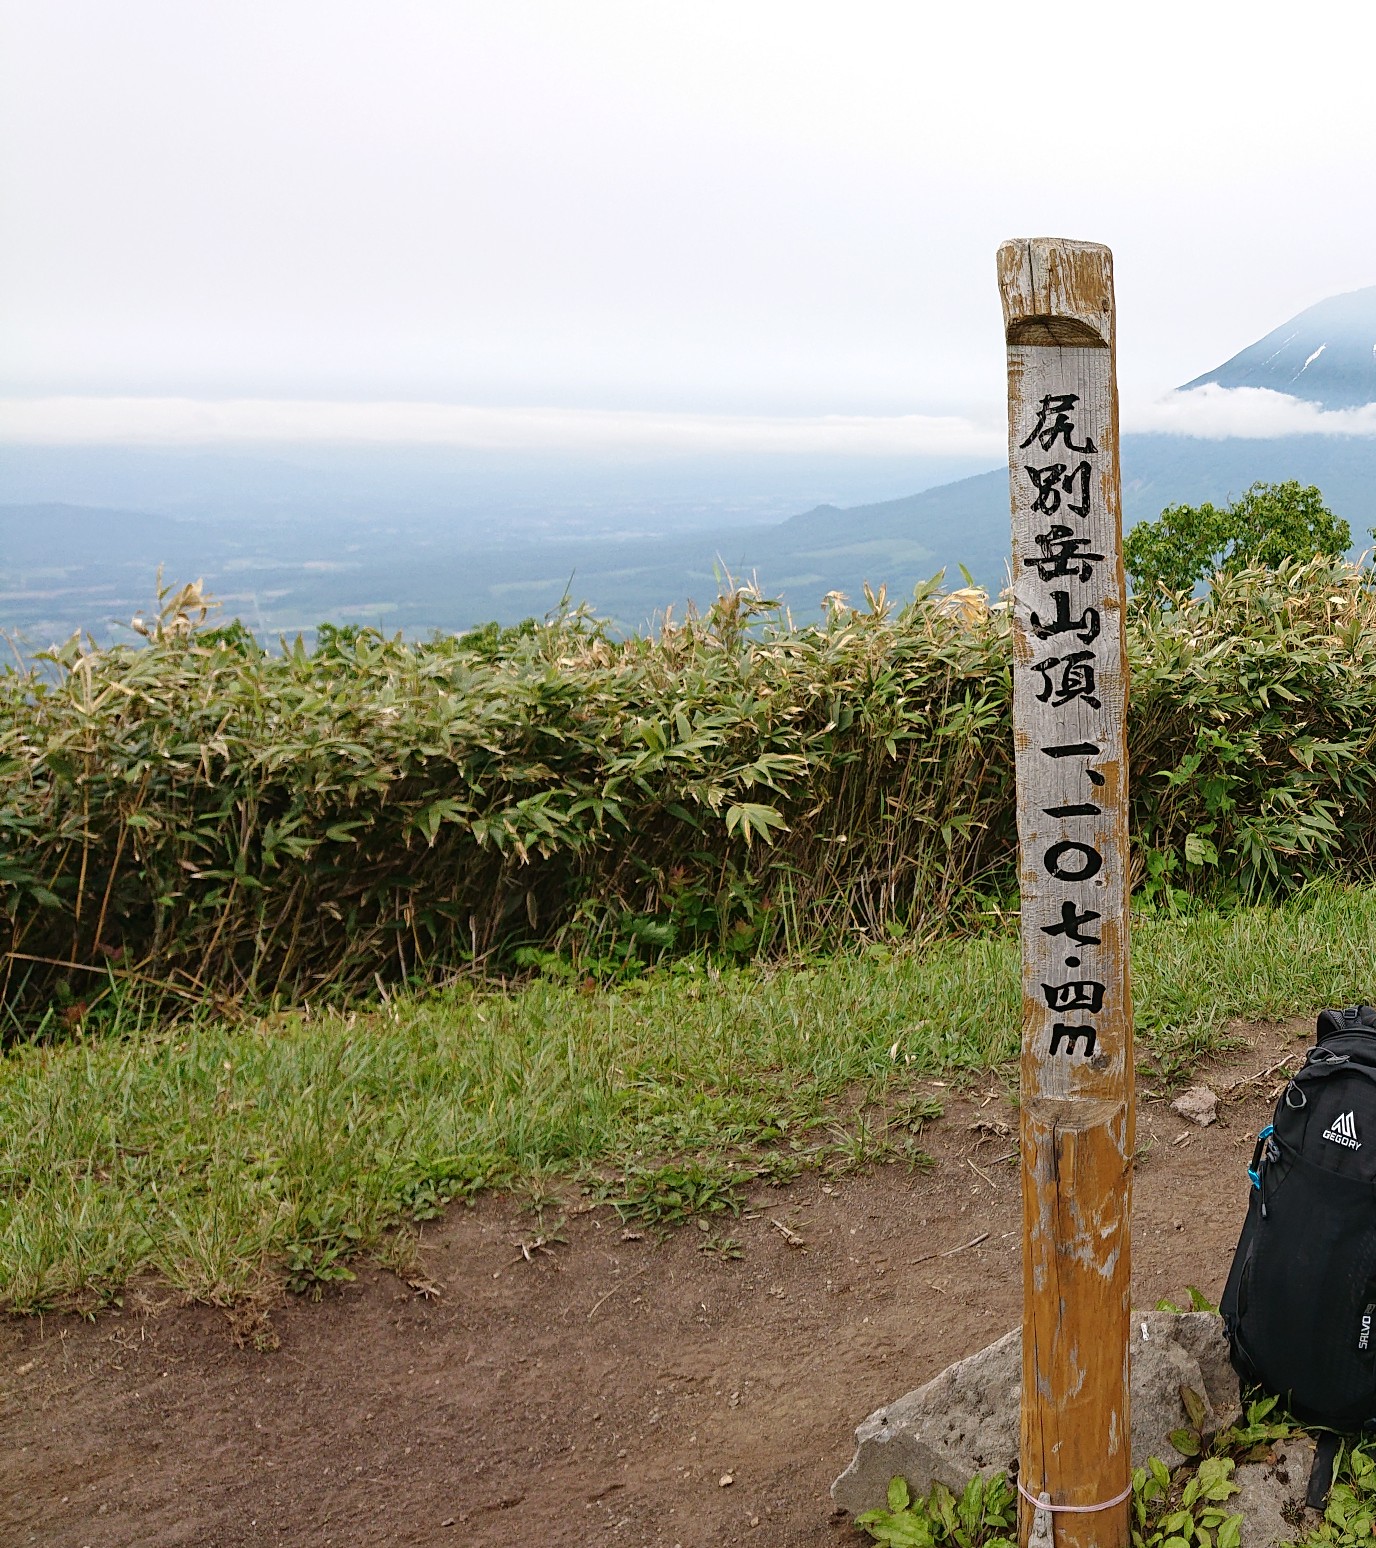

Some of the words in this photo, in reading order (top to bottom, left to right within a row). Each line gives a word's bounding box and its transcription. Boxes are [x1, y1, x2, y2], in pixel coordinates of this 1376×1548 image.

[1019, 393, 1105, 710] 尻別岳山頂
[1358, 1315, 1371, 1350] SALVO
